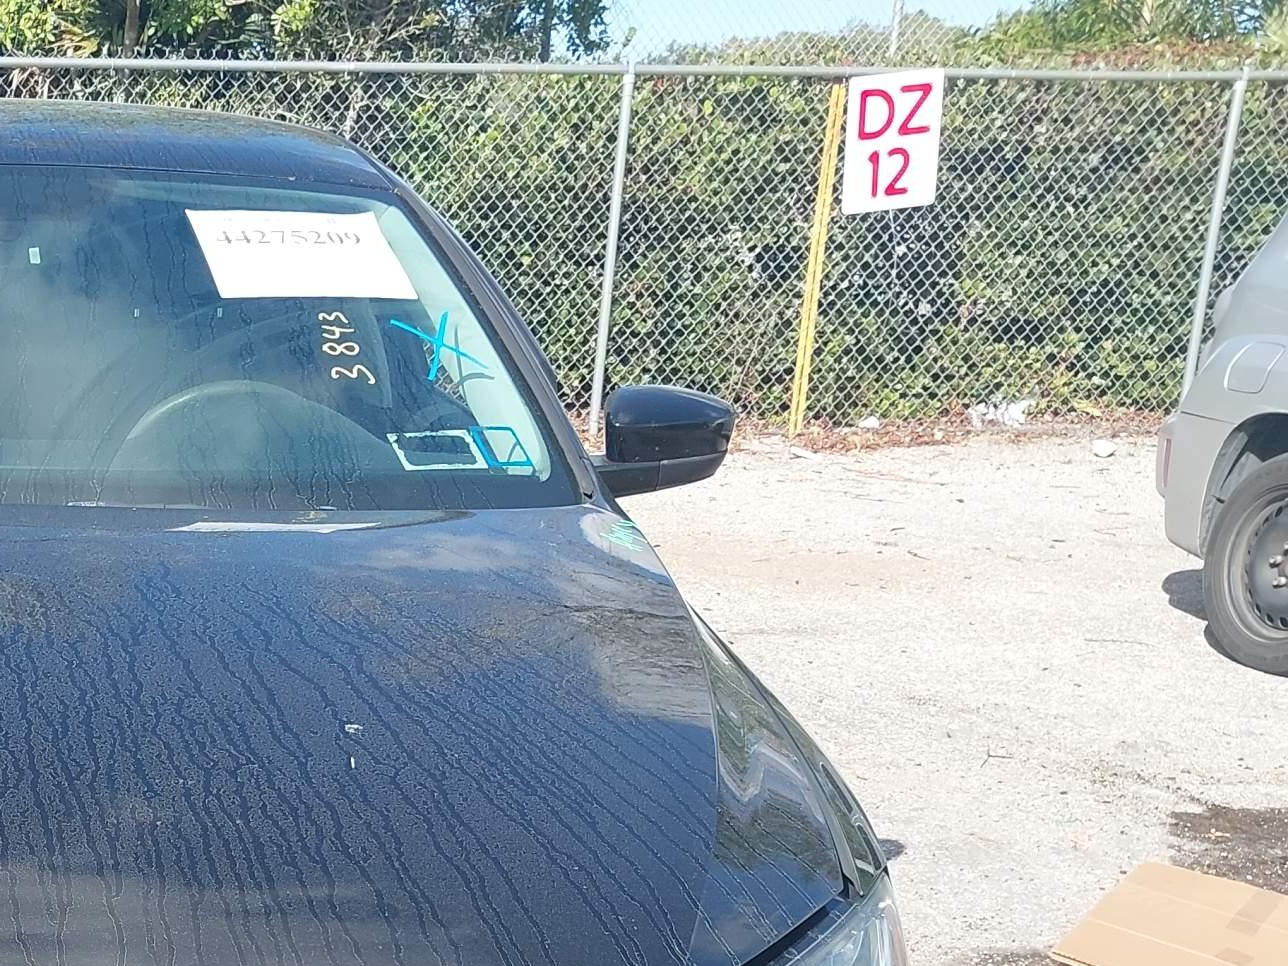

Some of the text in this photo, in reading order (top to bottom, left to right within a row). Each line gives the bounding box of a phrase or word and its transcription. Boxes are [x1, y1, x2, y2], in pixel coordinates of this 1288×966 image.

[858, 83, 933, 141] DZ
[868, 147, 910, 198] 12
[318, 311, 376, 385] 3843
